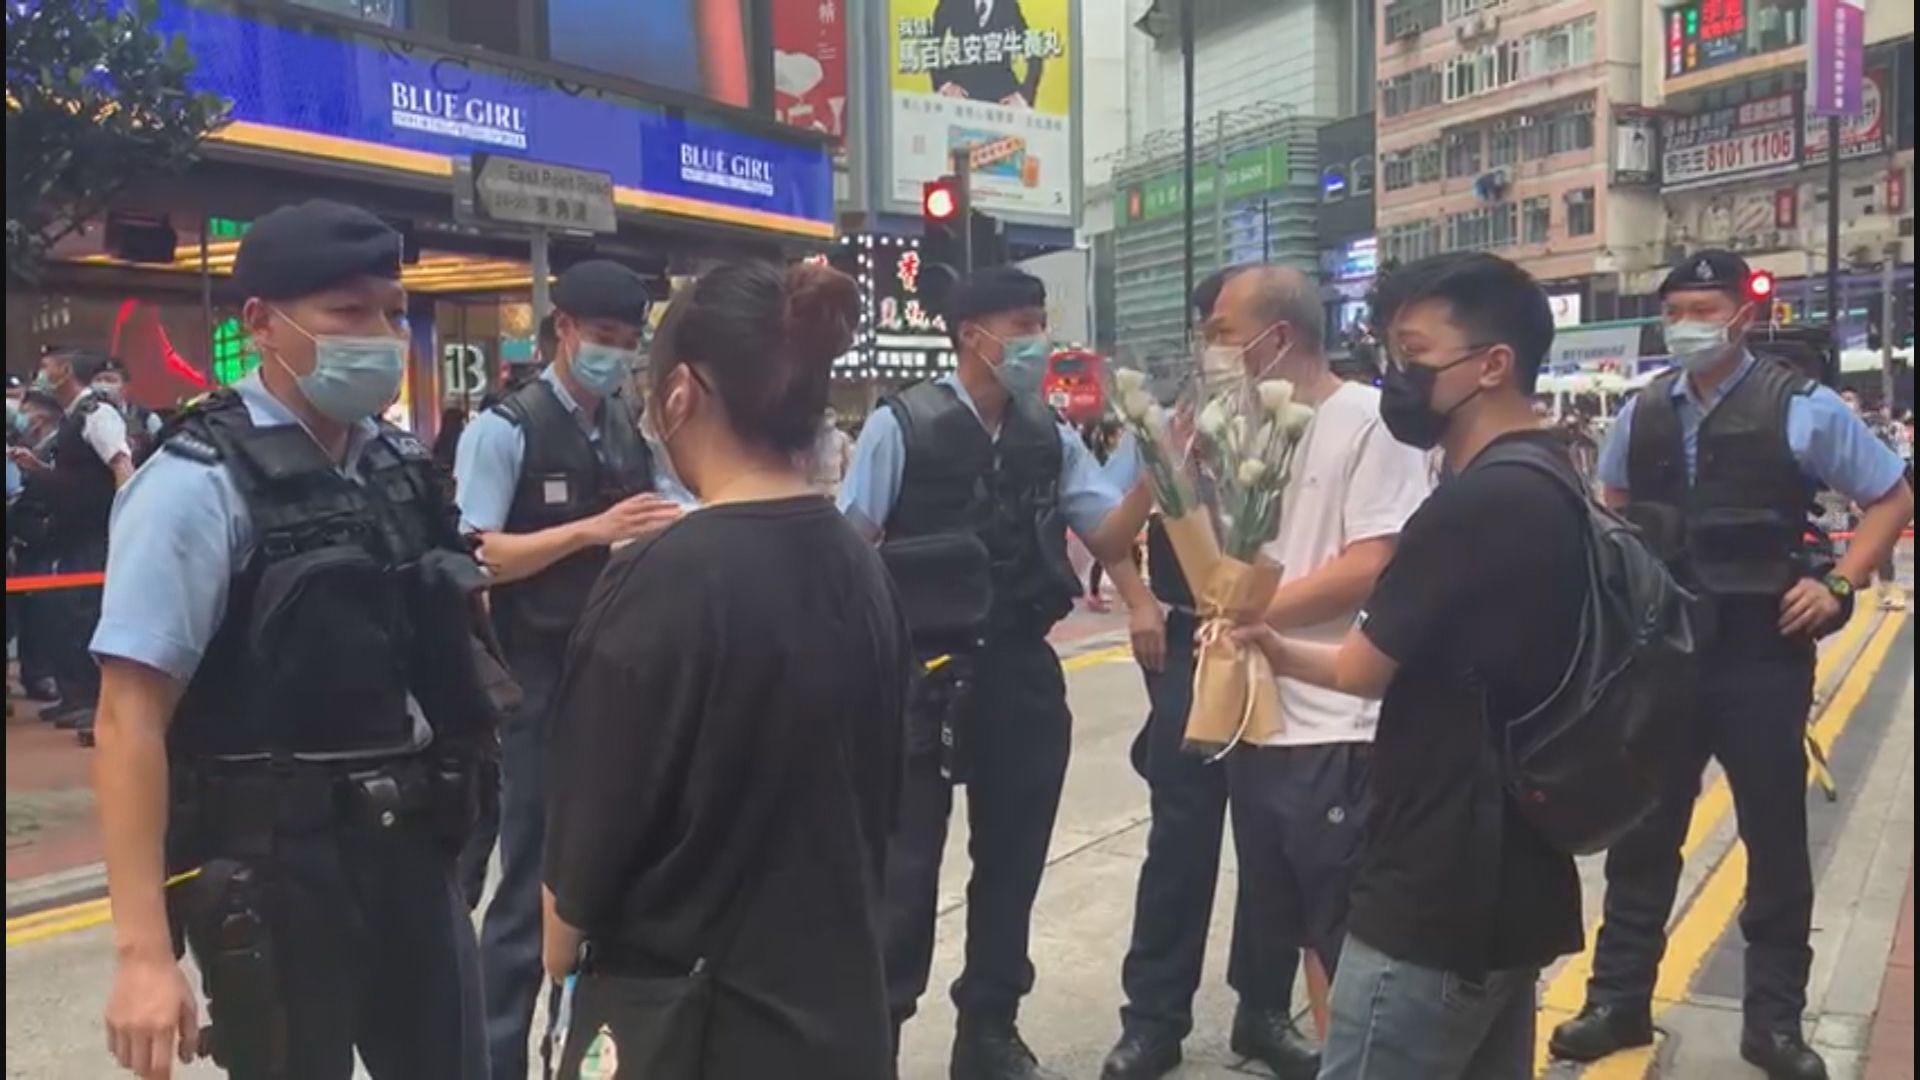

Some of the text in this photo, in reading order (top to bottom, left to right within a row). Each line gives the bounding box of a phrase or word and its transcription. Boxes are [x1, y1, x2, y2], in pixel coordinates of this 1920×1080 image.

[391, 81, 459, 119] BLUE
[465, 97, 526, 132] GIRL
[507, 163, 539, 185] East
[681, 142, 729, 175] BLUE
[730, 154, 775, 183] GIRL
